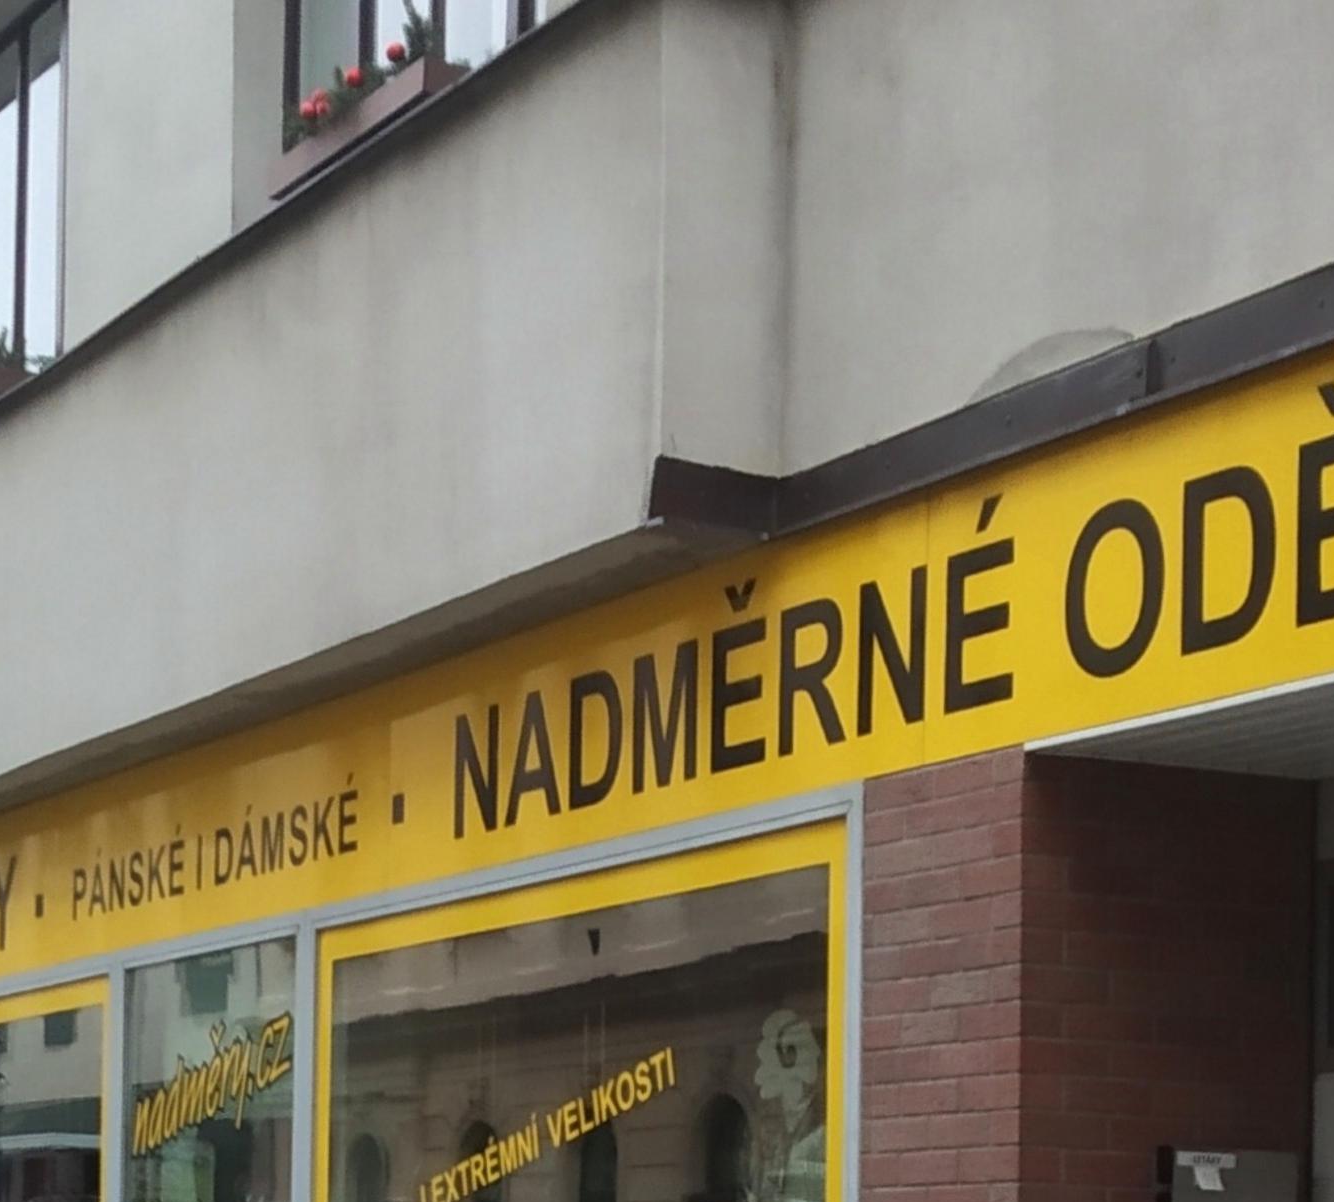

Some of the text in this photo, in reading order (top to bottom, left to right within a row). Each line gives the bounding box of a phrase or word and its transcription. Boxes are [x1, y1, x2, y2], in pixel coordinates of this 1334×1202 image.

[72, 823, 185, 920] PÁNSKÉ
[196, 834, 203, 890] I
[214, 772, 358, 886] DÁMSKÉ
[454, 494, 1015, 839] NADMĚRNÉ
[546, 1047, 675, 1148] VELIKOSTI
